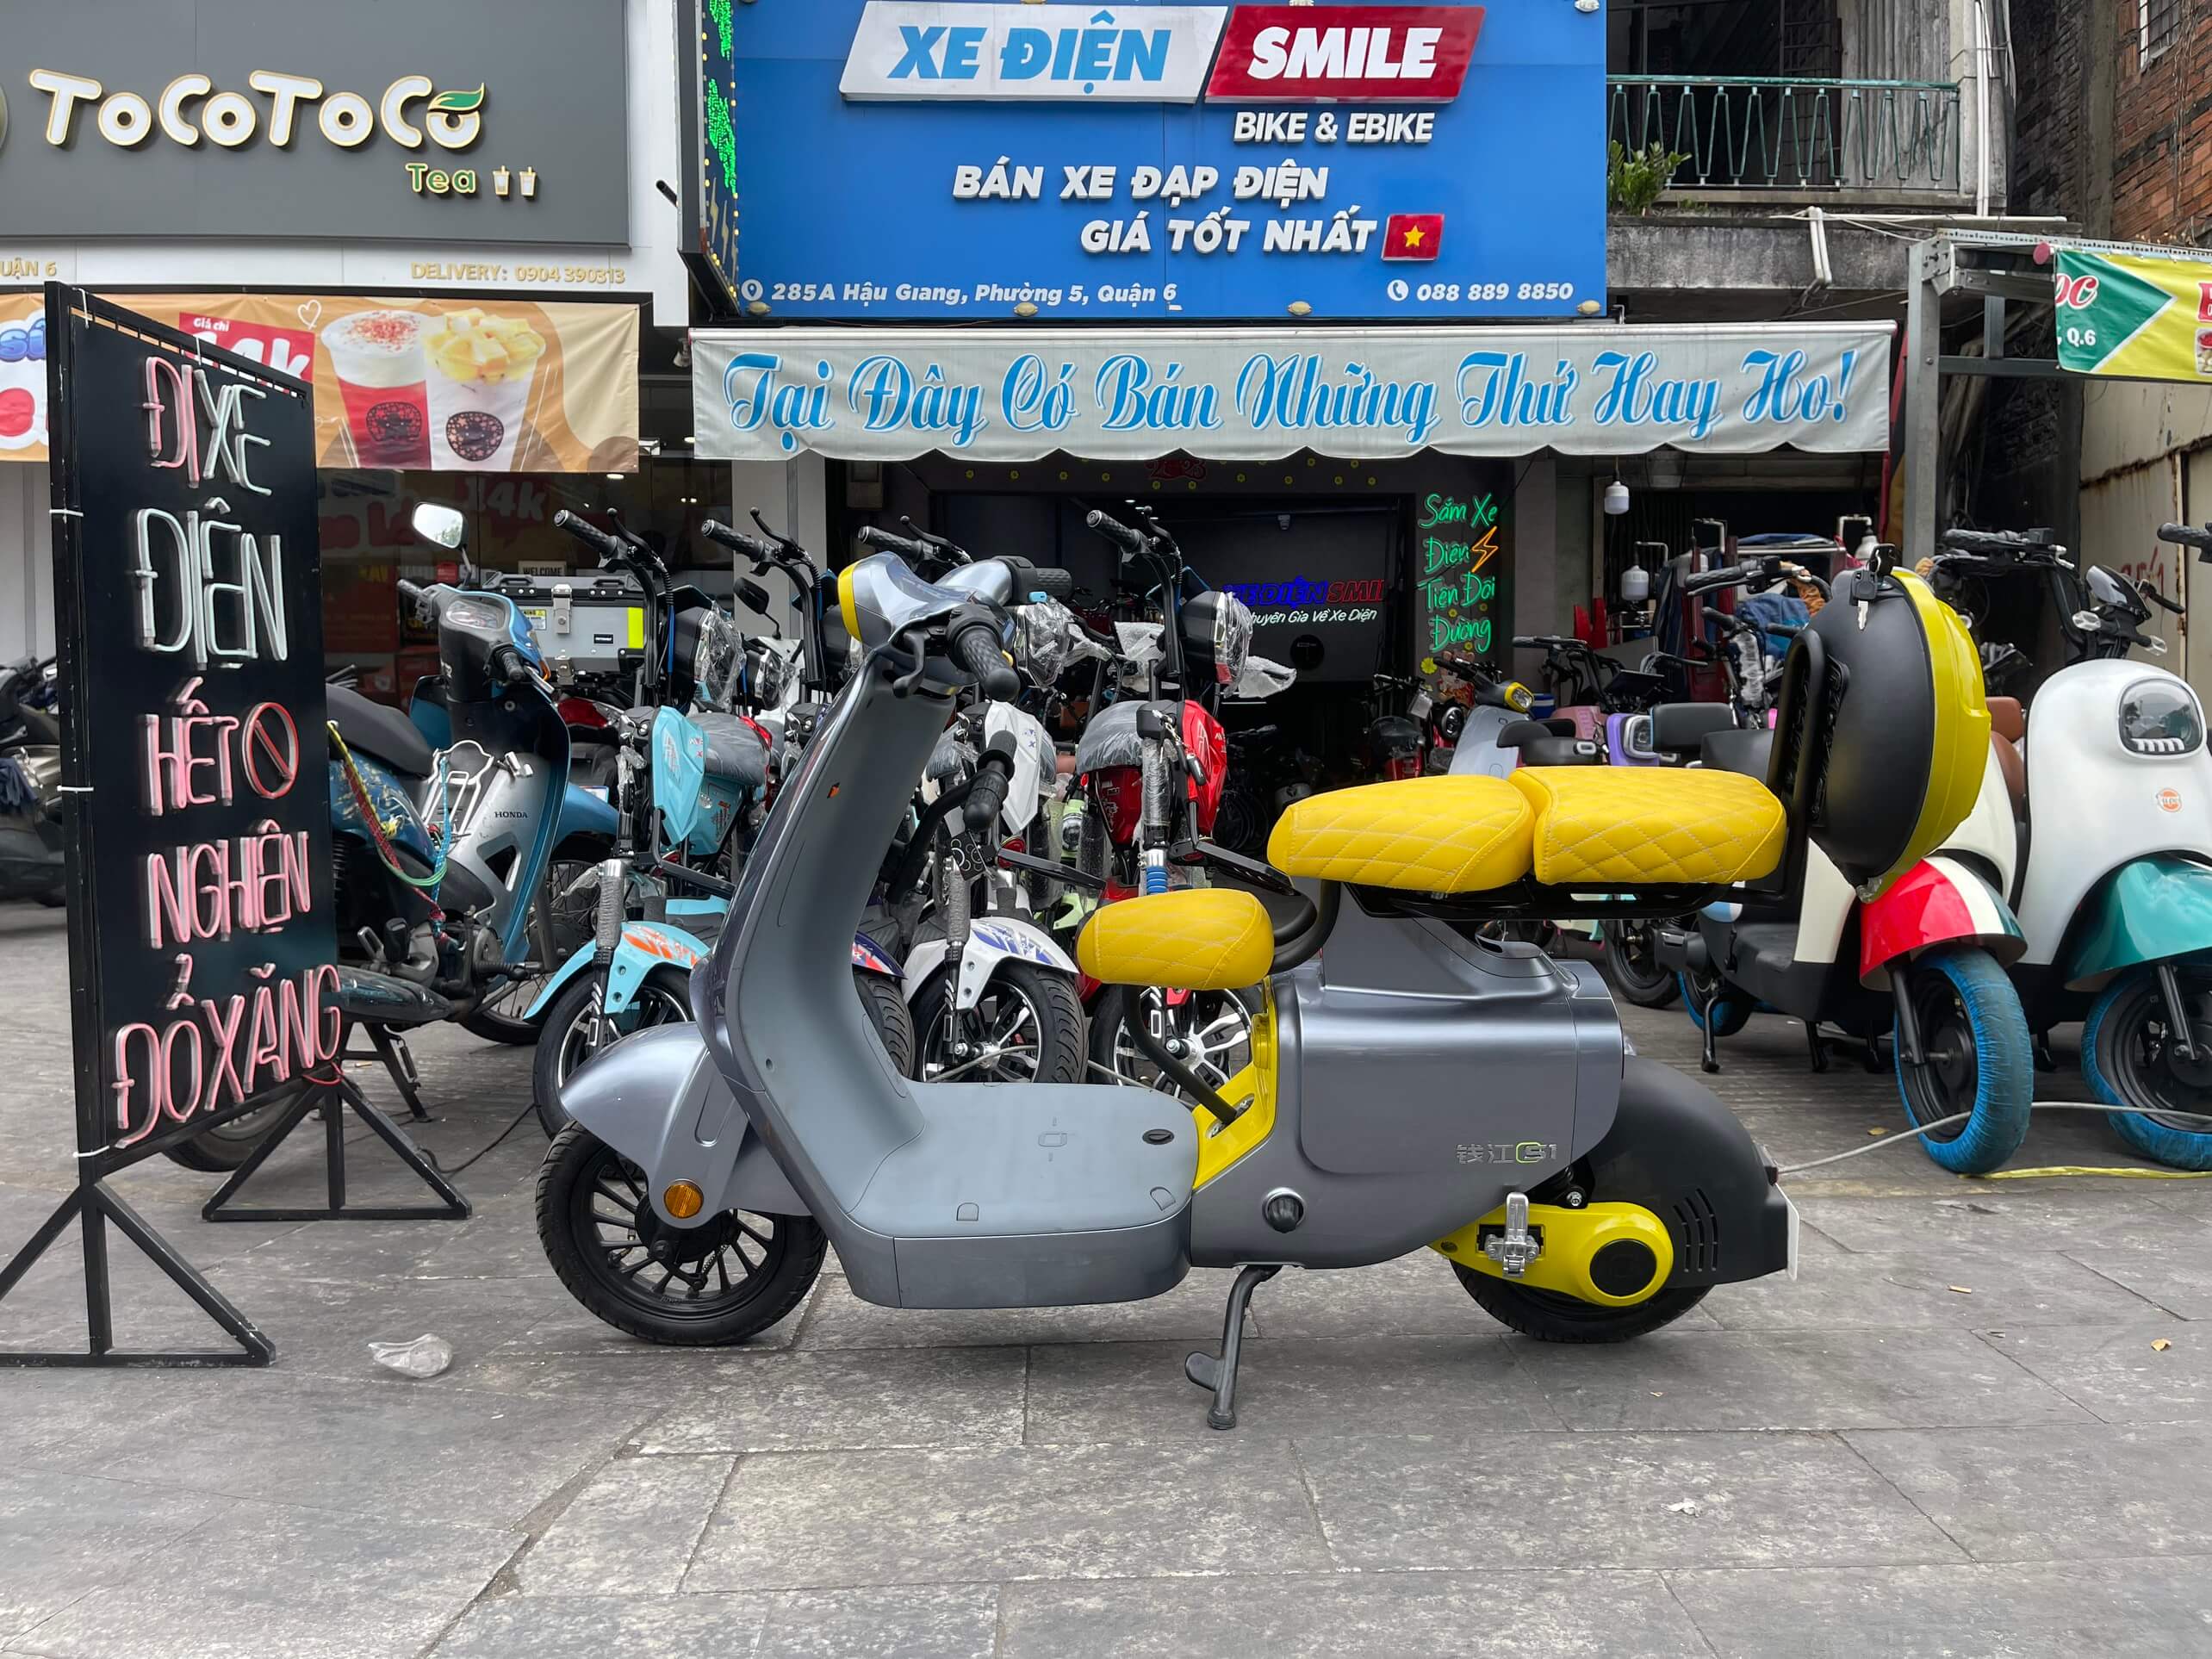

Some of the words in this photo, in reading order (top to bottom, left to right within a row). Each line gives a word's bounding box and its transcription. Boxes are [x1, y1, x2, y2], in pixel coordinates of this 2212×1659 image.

[887, 26, 987, 79] XE
[999, 9, 1171, 94] ĐIỆN
[1247, 27, 1443, 78] SMILE
[1234, 112, 1308, 143] BIKE
[1315, 112, 1339, 142] &
[1347, 112, 1435, 143] EBIKE
[406, 163, 476, 196] Tea
[953, 156, 1043, 199] BÁN
[1060, 165, 1116, 199] XE
[1131, 165, 1219, 208] ĐẠP
[1233, 158, 1328, 208] ĐIỆN
[1080, 210, 1150, 253] GIÁ
[1169, 206, 1250, 253] TỐT
[1264, 206, 1377, 252] NHẤT
[0, 258, 39, 280] UẬN
[46, 261, 57, 276] 6
[411, 261, 507, 281] DELIVERY:
[515, 264, 560, 283] 0904
[564, 266, 625, 284] 390313
[771, 283, 836, 301] 285A
[843, 282, 888, 308] Hậu
[975, 282, 1063, 307] Phường
[1067, 284, 1090, 305] 5,
[1097, 283, 1157, 308] Quận
[1163, 283, 1177, 301] 6
[1416, 283, 1461, 301] 088
[1467, 283, 1510, 300] 889
[1517, 282, 1575, 300] 8850
[2066, 327, 2097, 347] Q.6
[724, 352, 834, 453] Tại
[848, 352, 985, 448] Đây
[1000, 352, 1082, 433] Có
[1095, 352, 1221, 432] Bán
[1236, 351, 1442, 444] Những
[1455, 351, 1580, 428] Thứ
[1591, 351, 1724, 441] Hay
[1740, 348, 1861, 425] Ho!
[1419, 494, 1468, 529] Sắm
[1470, 493, 1499, 529] Xe
[133, 497, 289, 670] ĐIỆN
[1251, 611, 1286, 626] huyên
[1288, 611, 1308, 623] Gia
[1312, 608, 1330, 622] Về
[1328, 610, 1346, 622] Xe
[1348, 609, 1377, 623] Điện
[146, 676, 240, 816] HẾT
[147, 819, 310, 949] NGHIỆN
